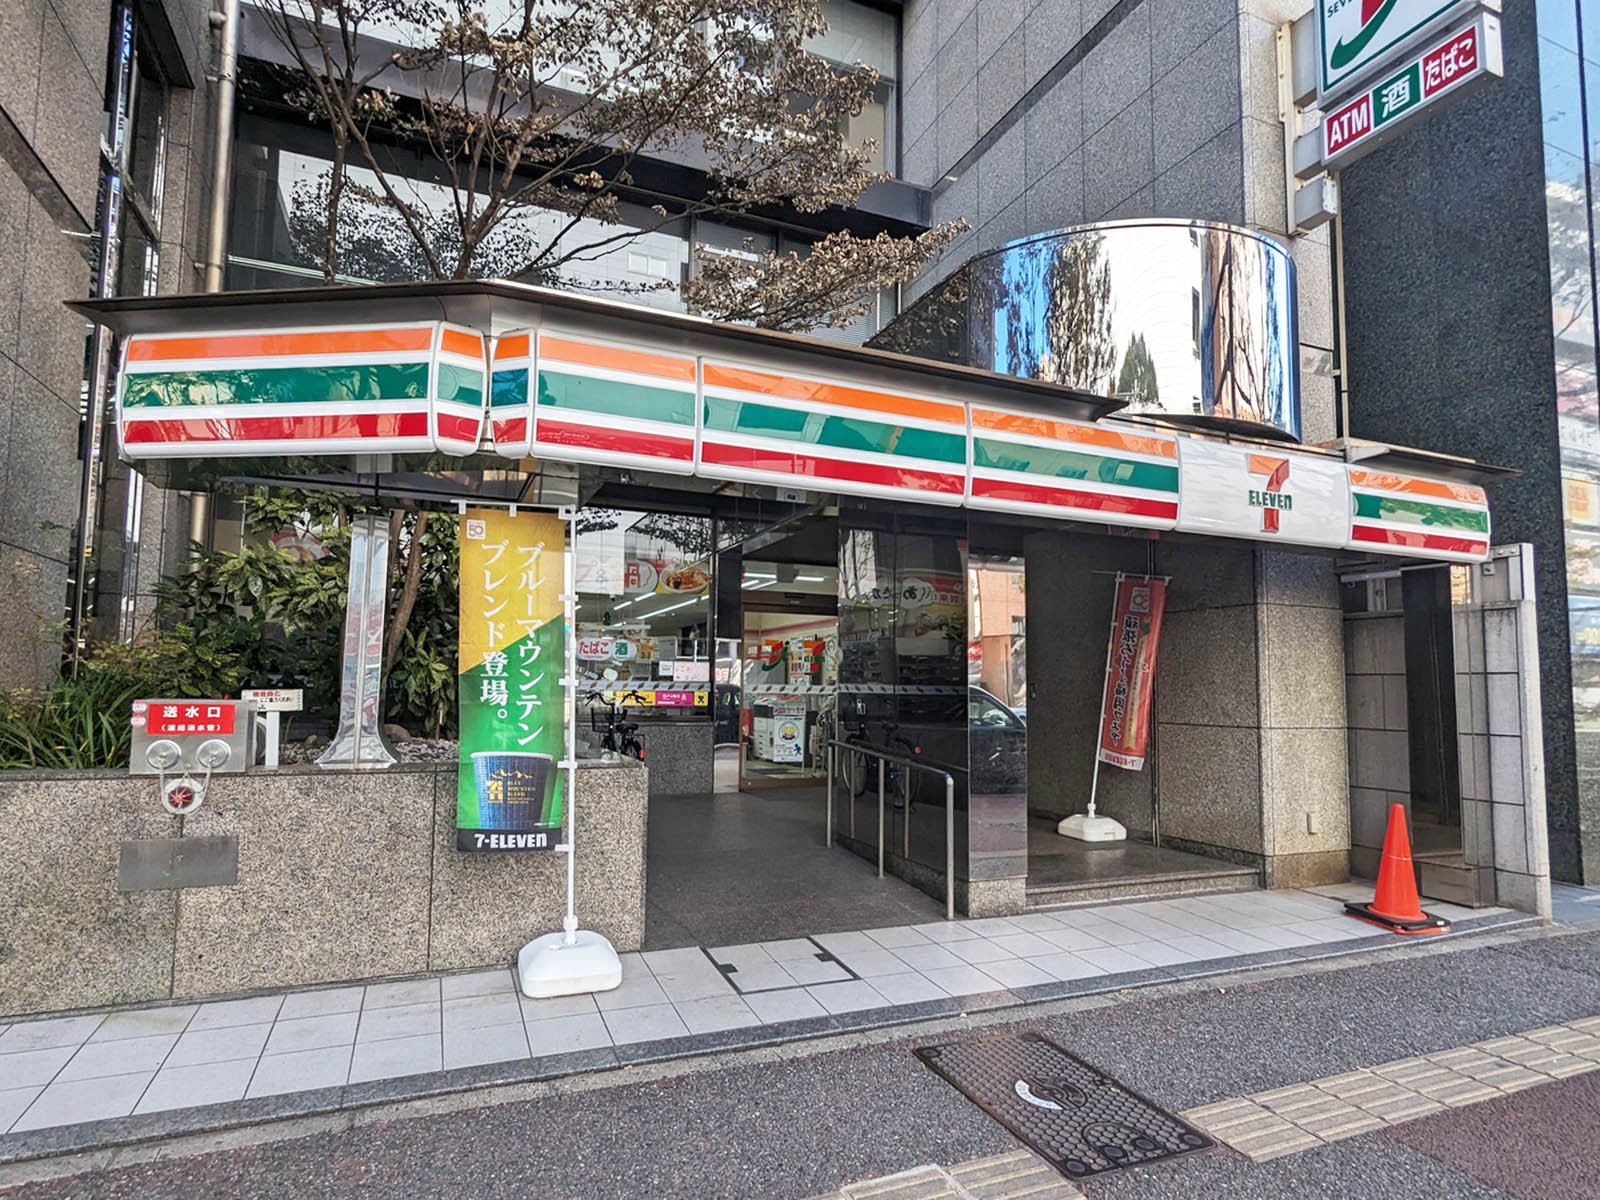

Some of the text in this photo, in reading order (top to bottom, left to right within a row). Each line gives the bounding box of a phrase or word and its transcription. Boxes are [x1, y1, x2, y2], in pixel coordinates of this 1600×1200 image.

[1327, 0, 1352, 18] SEV
[1425, 38, 1475, 91] たばこ
[1382, 74, 1411, 118] 酒
[1330, 102, 1368, 149] ATM
[480, 539, 510, 719] ブレンド登場。
[516, 541, 545, 746] ブルーマウンテン
[578, 640, 609, 655] たばこ
[162, 705, 221, 718] 送水口
